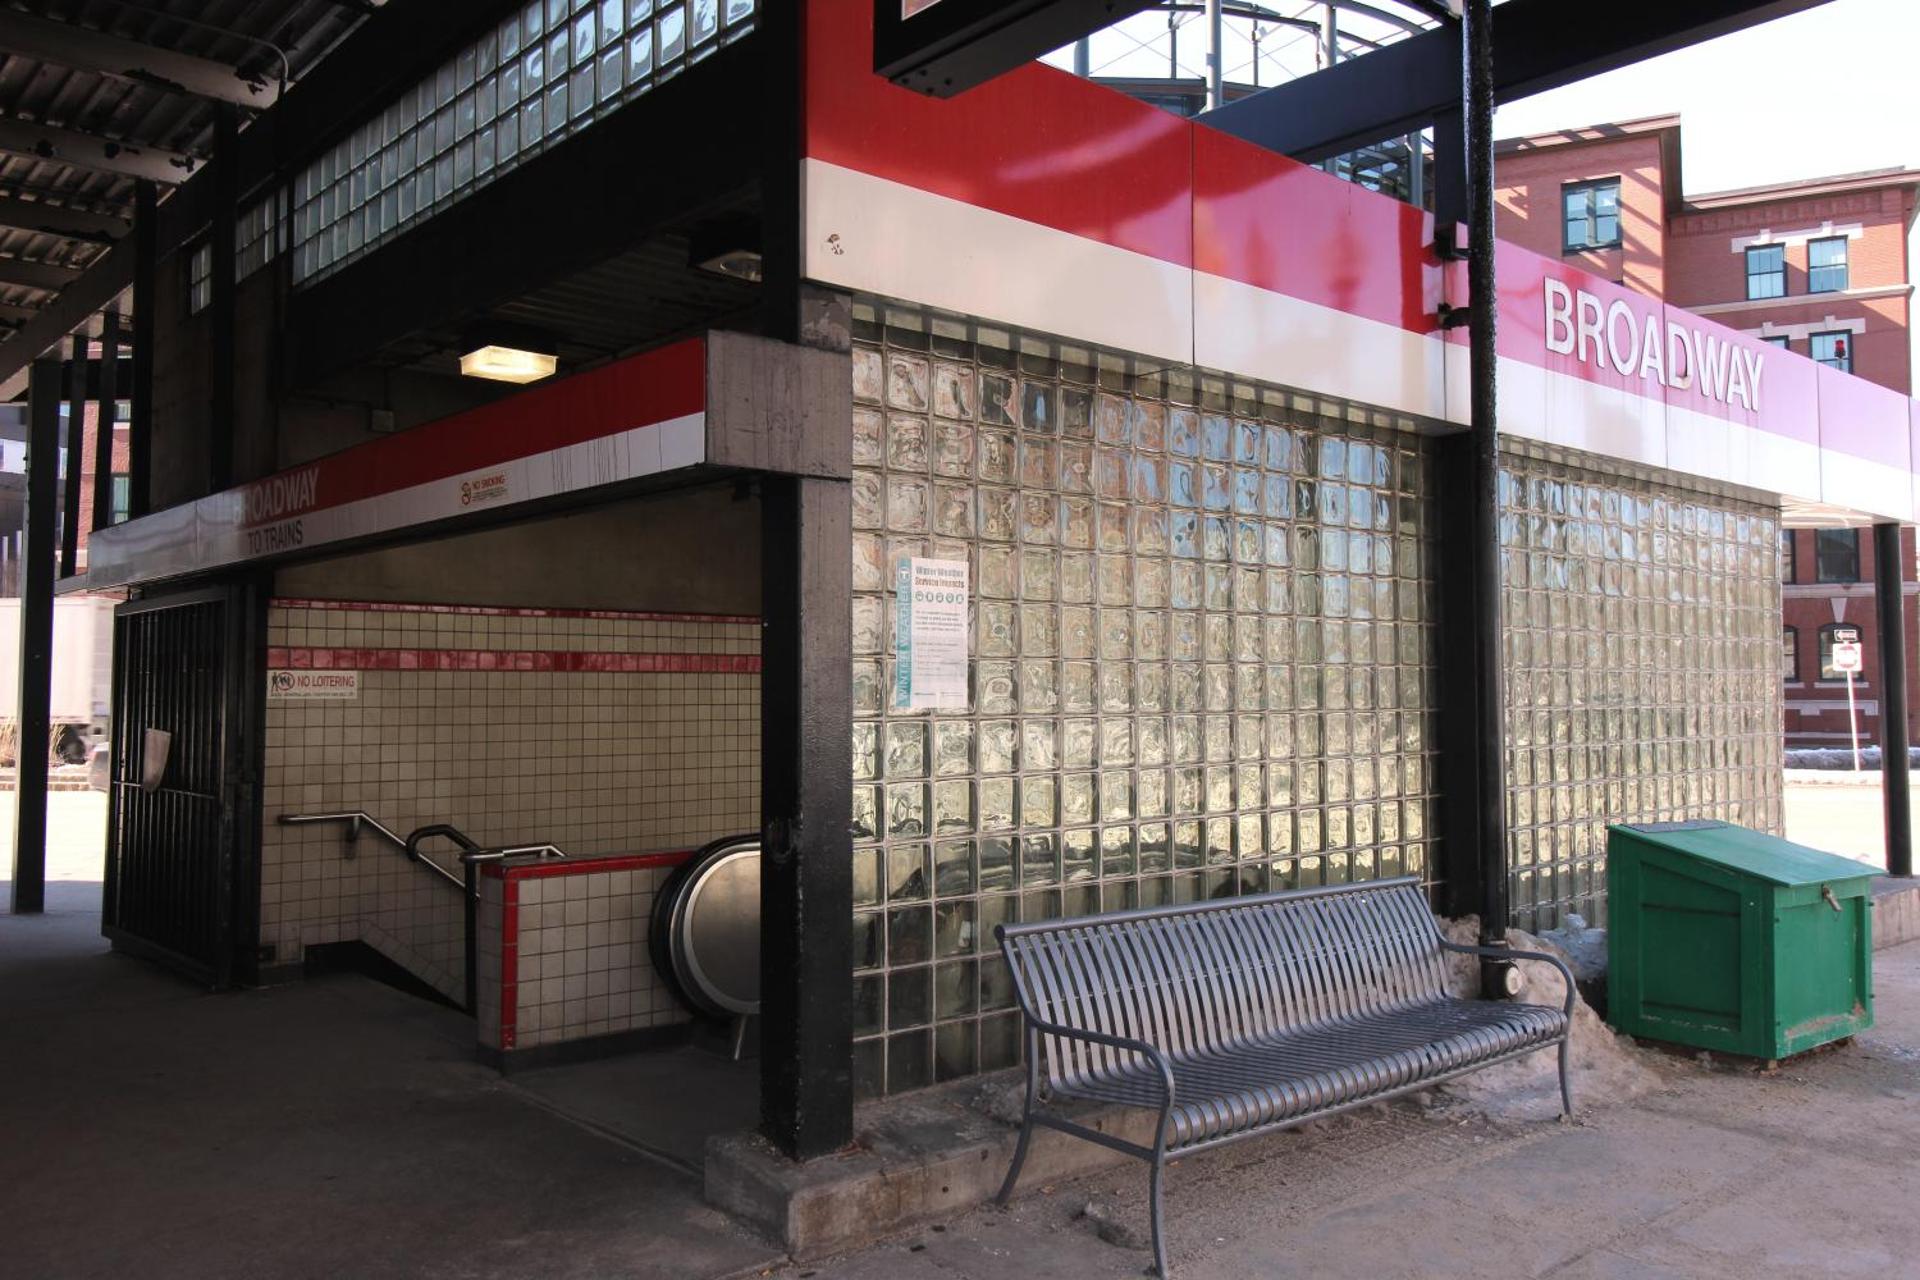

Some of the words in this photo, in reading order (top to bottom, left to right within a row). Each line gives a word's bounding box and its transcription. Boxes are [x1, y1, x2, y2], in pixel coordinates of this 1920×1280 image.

[1544, 276, 1763, 412] BROADWAY
[481, 474, 506, 488] SMOKING
[248, 530, 261, 555] TO
[263, 520, 303, 553] TRAINS
[915, 576, 938, 586] Service
[297, 675, 310, 687] NO
[312, 675, 355, 687] LOITERING
